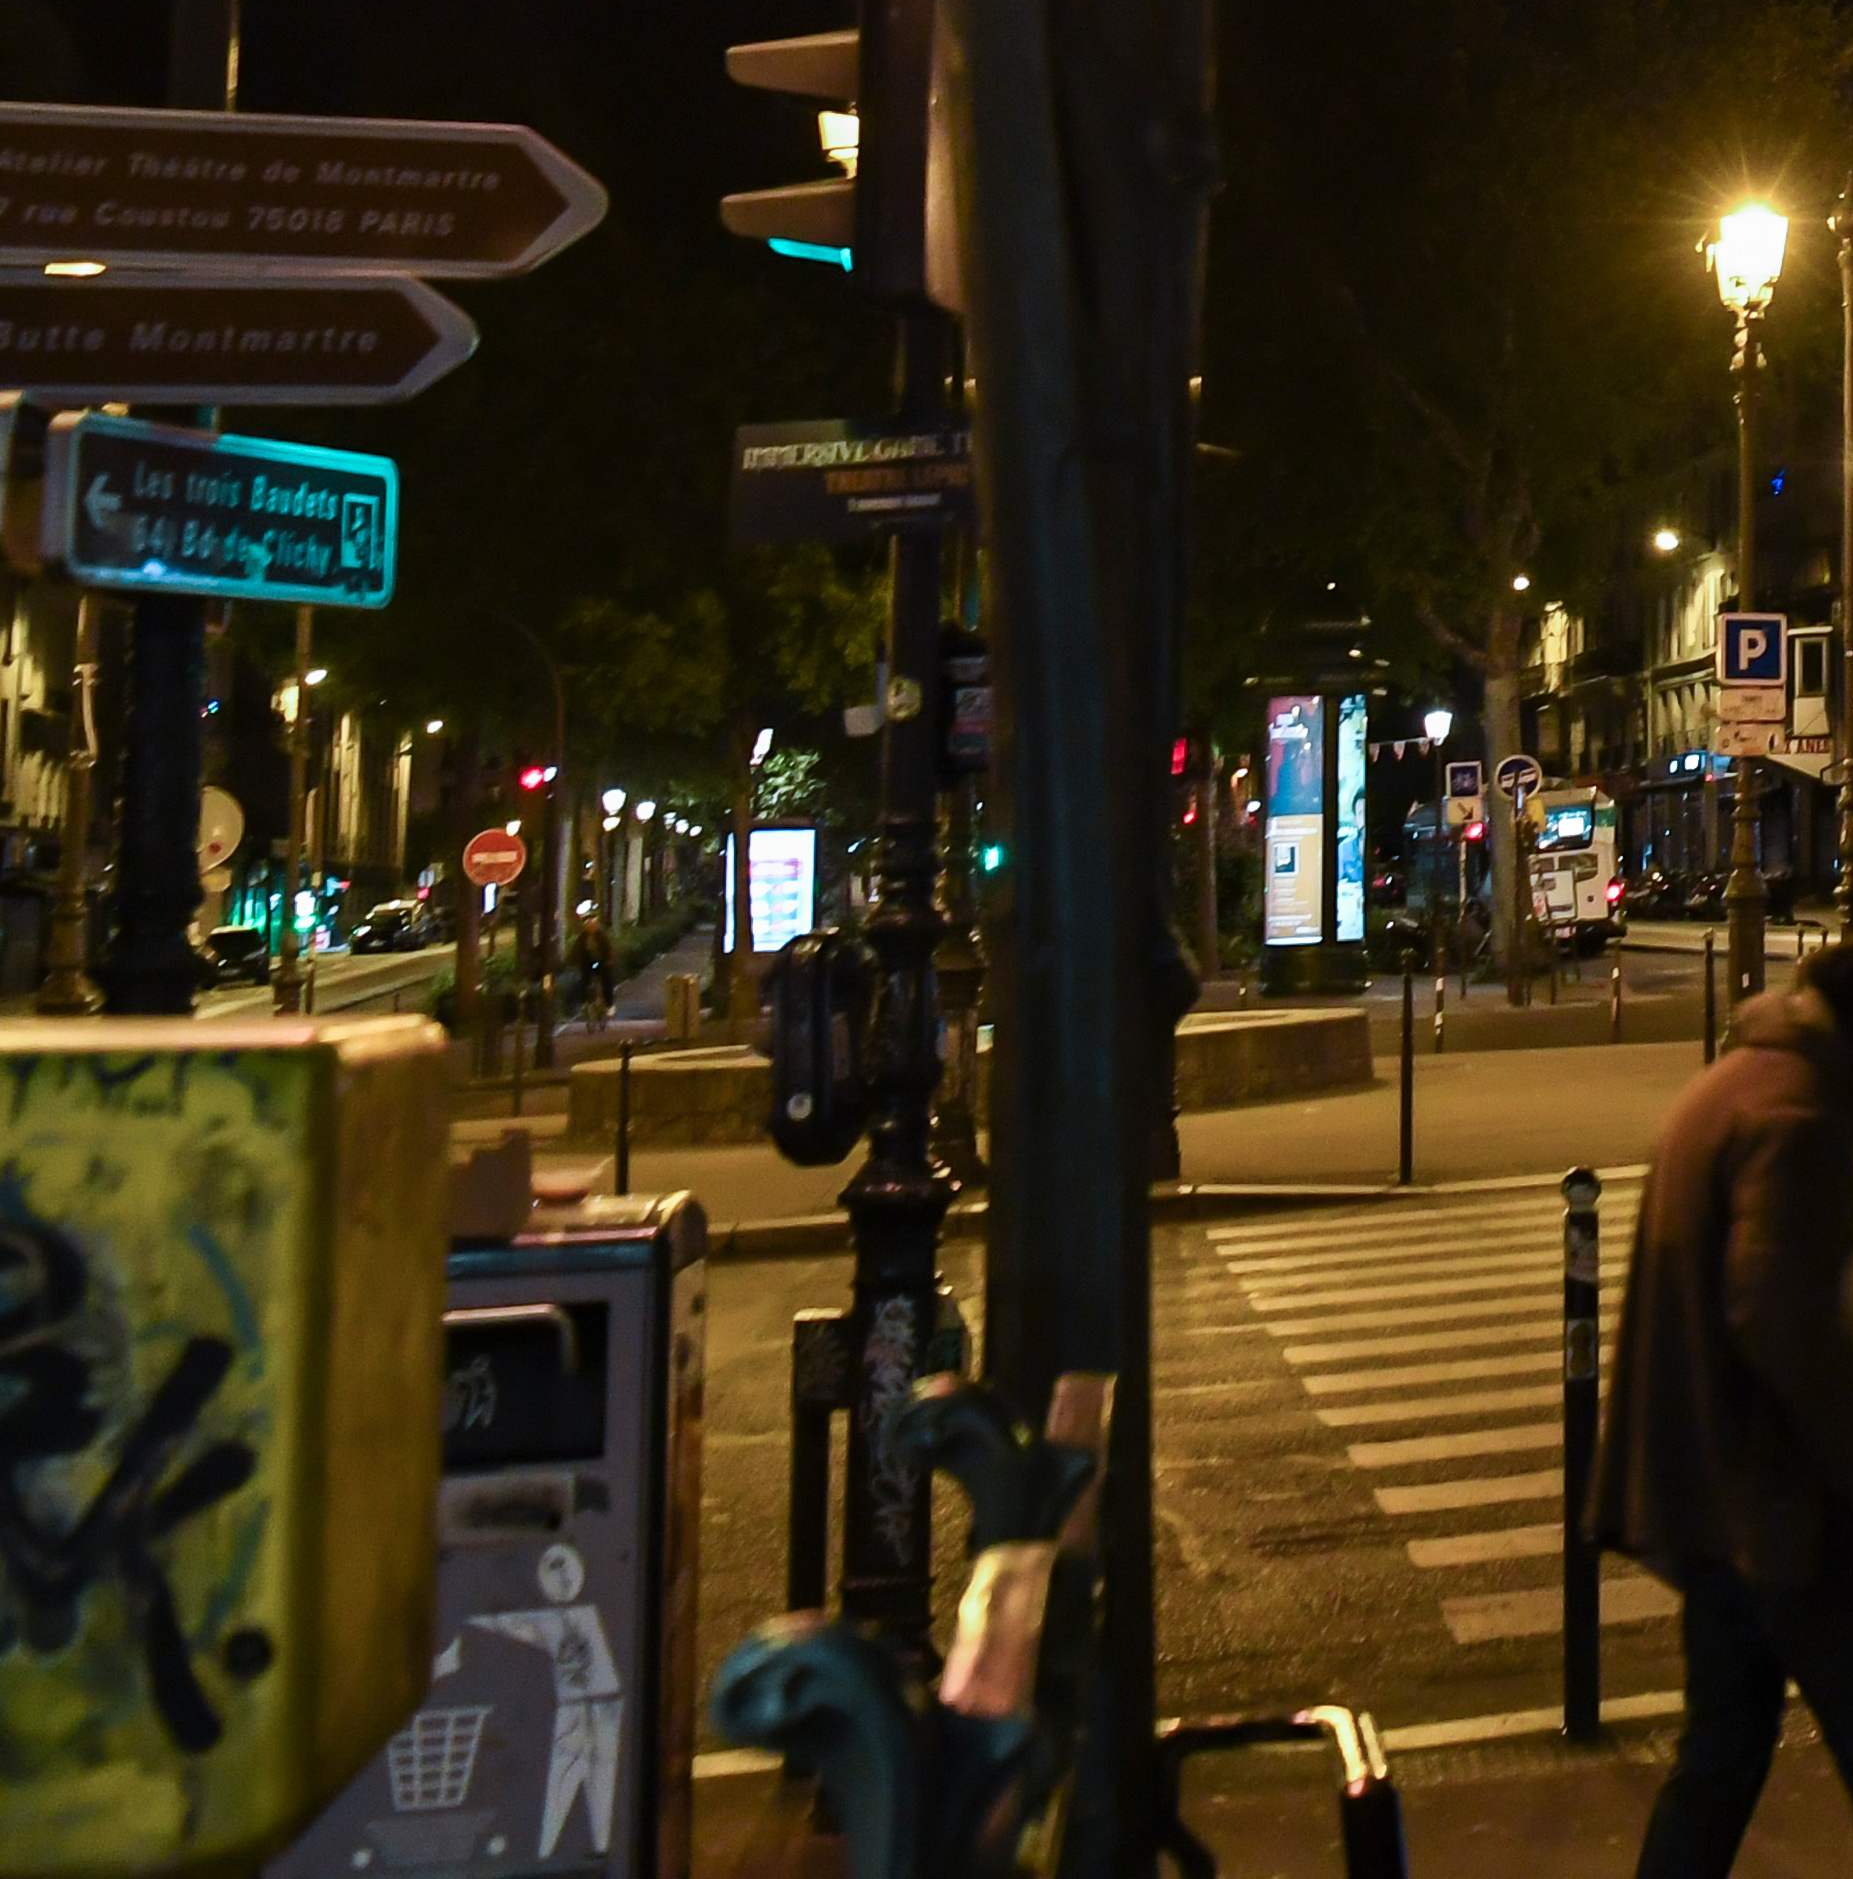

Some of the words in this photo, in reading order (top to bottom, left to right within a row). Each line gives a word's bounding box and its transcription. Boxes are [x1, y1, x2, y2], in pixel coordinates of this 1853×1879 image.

[128, 151, 247, 182] Théâtre
[261, 160, 301, 184] de
[316, 159, 500, 191] Montmartre
[24, 203, 80, 226] rue
[96, 198, 233, 230] Coustou
[248, 205, 345, 233] 75018
[357, 208, 455, 238] PARIS
[128, 320, 382, 355] Montmartre
[133, 461, 174, 501] Les
[185, 471, 242, 508] trois
[251, 474, 340, 520] Baudets
[1738, 628, 1769, 671] P
